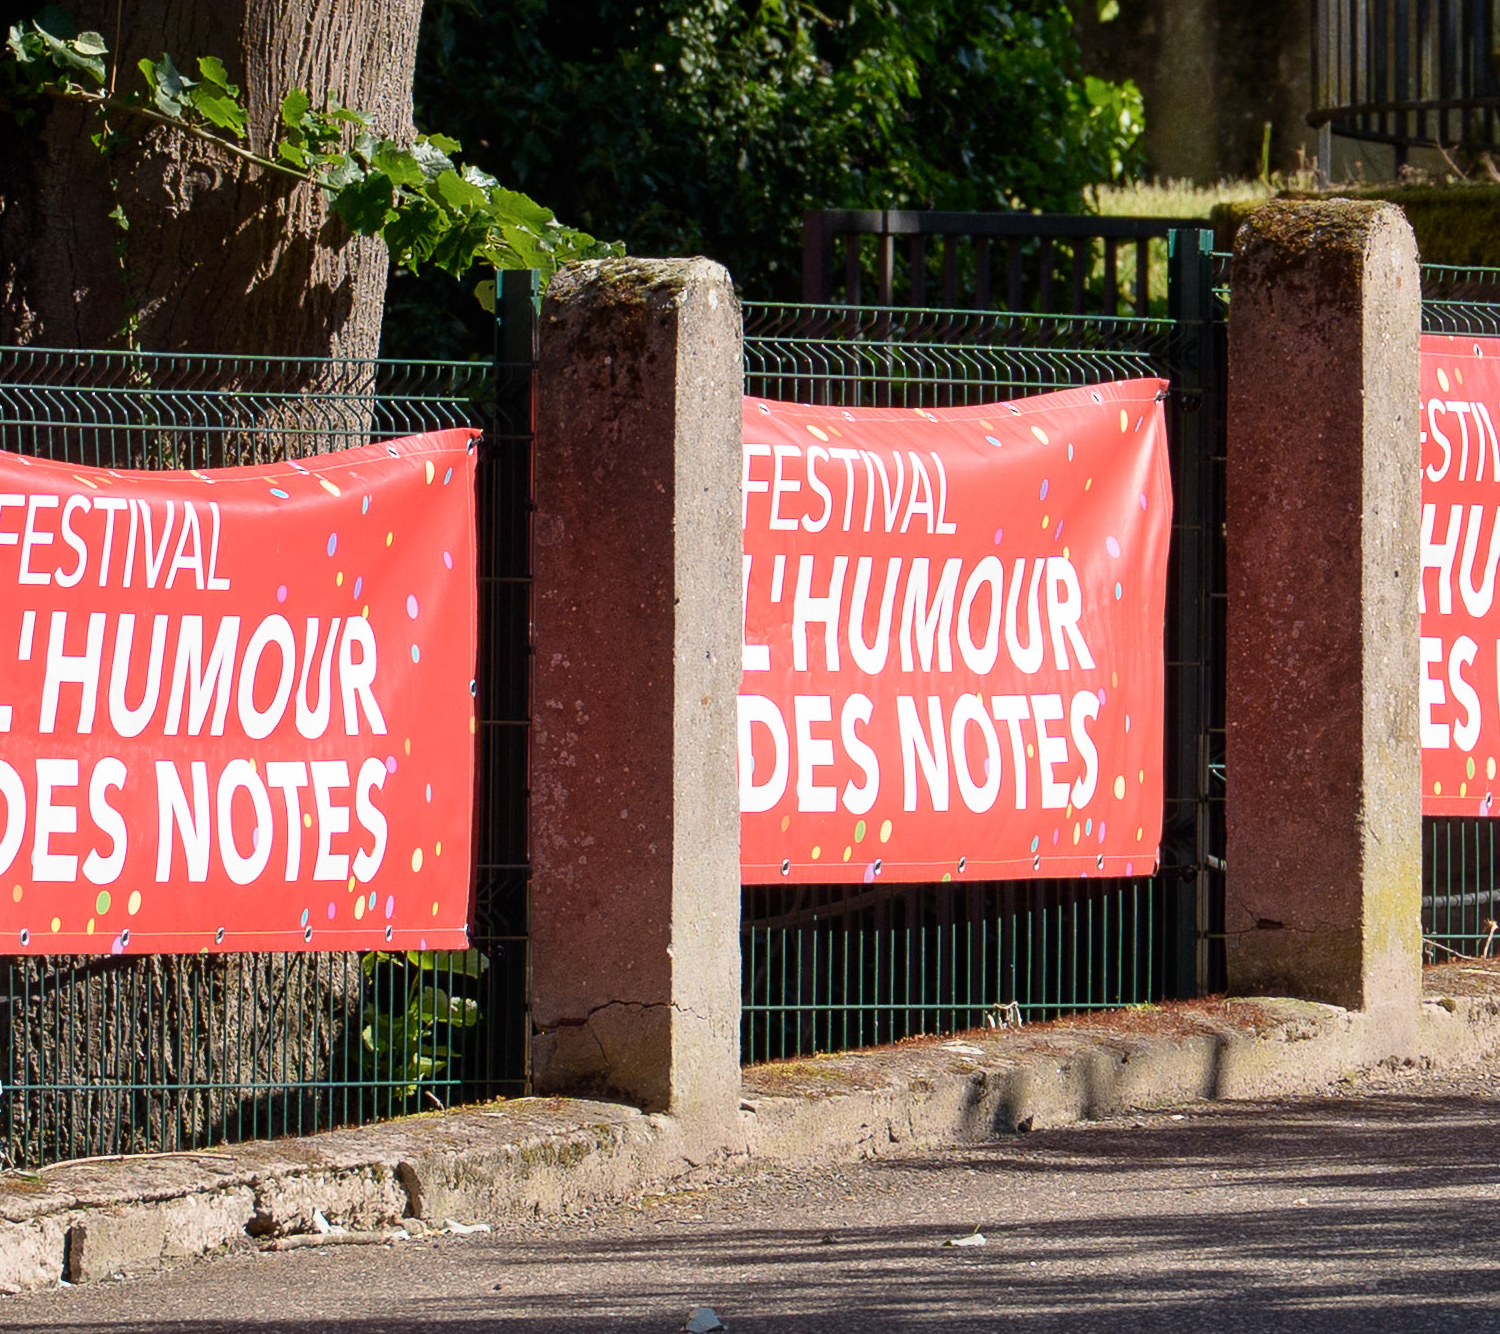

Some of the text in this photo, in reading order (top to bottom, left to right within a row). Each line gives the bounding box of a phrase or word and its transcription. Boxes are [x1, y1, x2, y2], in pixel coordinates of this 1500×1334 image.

[741, 443, 957, 535] FESTIVAL
[741, 554, 1096, 676] L'HUMOUR
[736, 690, 1100, 815] DES NOTES
[1419, 634, 1482, 753] ES
[155, 757, 389, 886] NOTES
